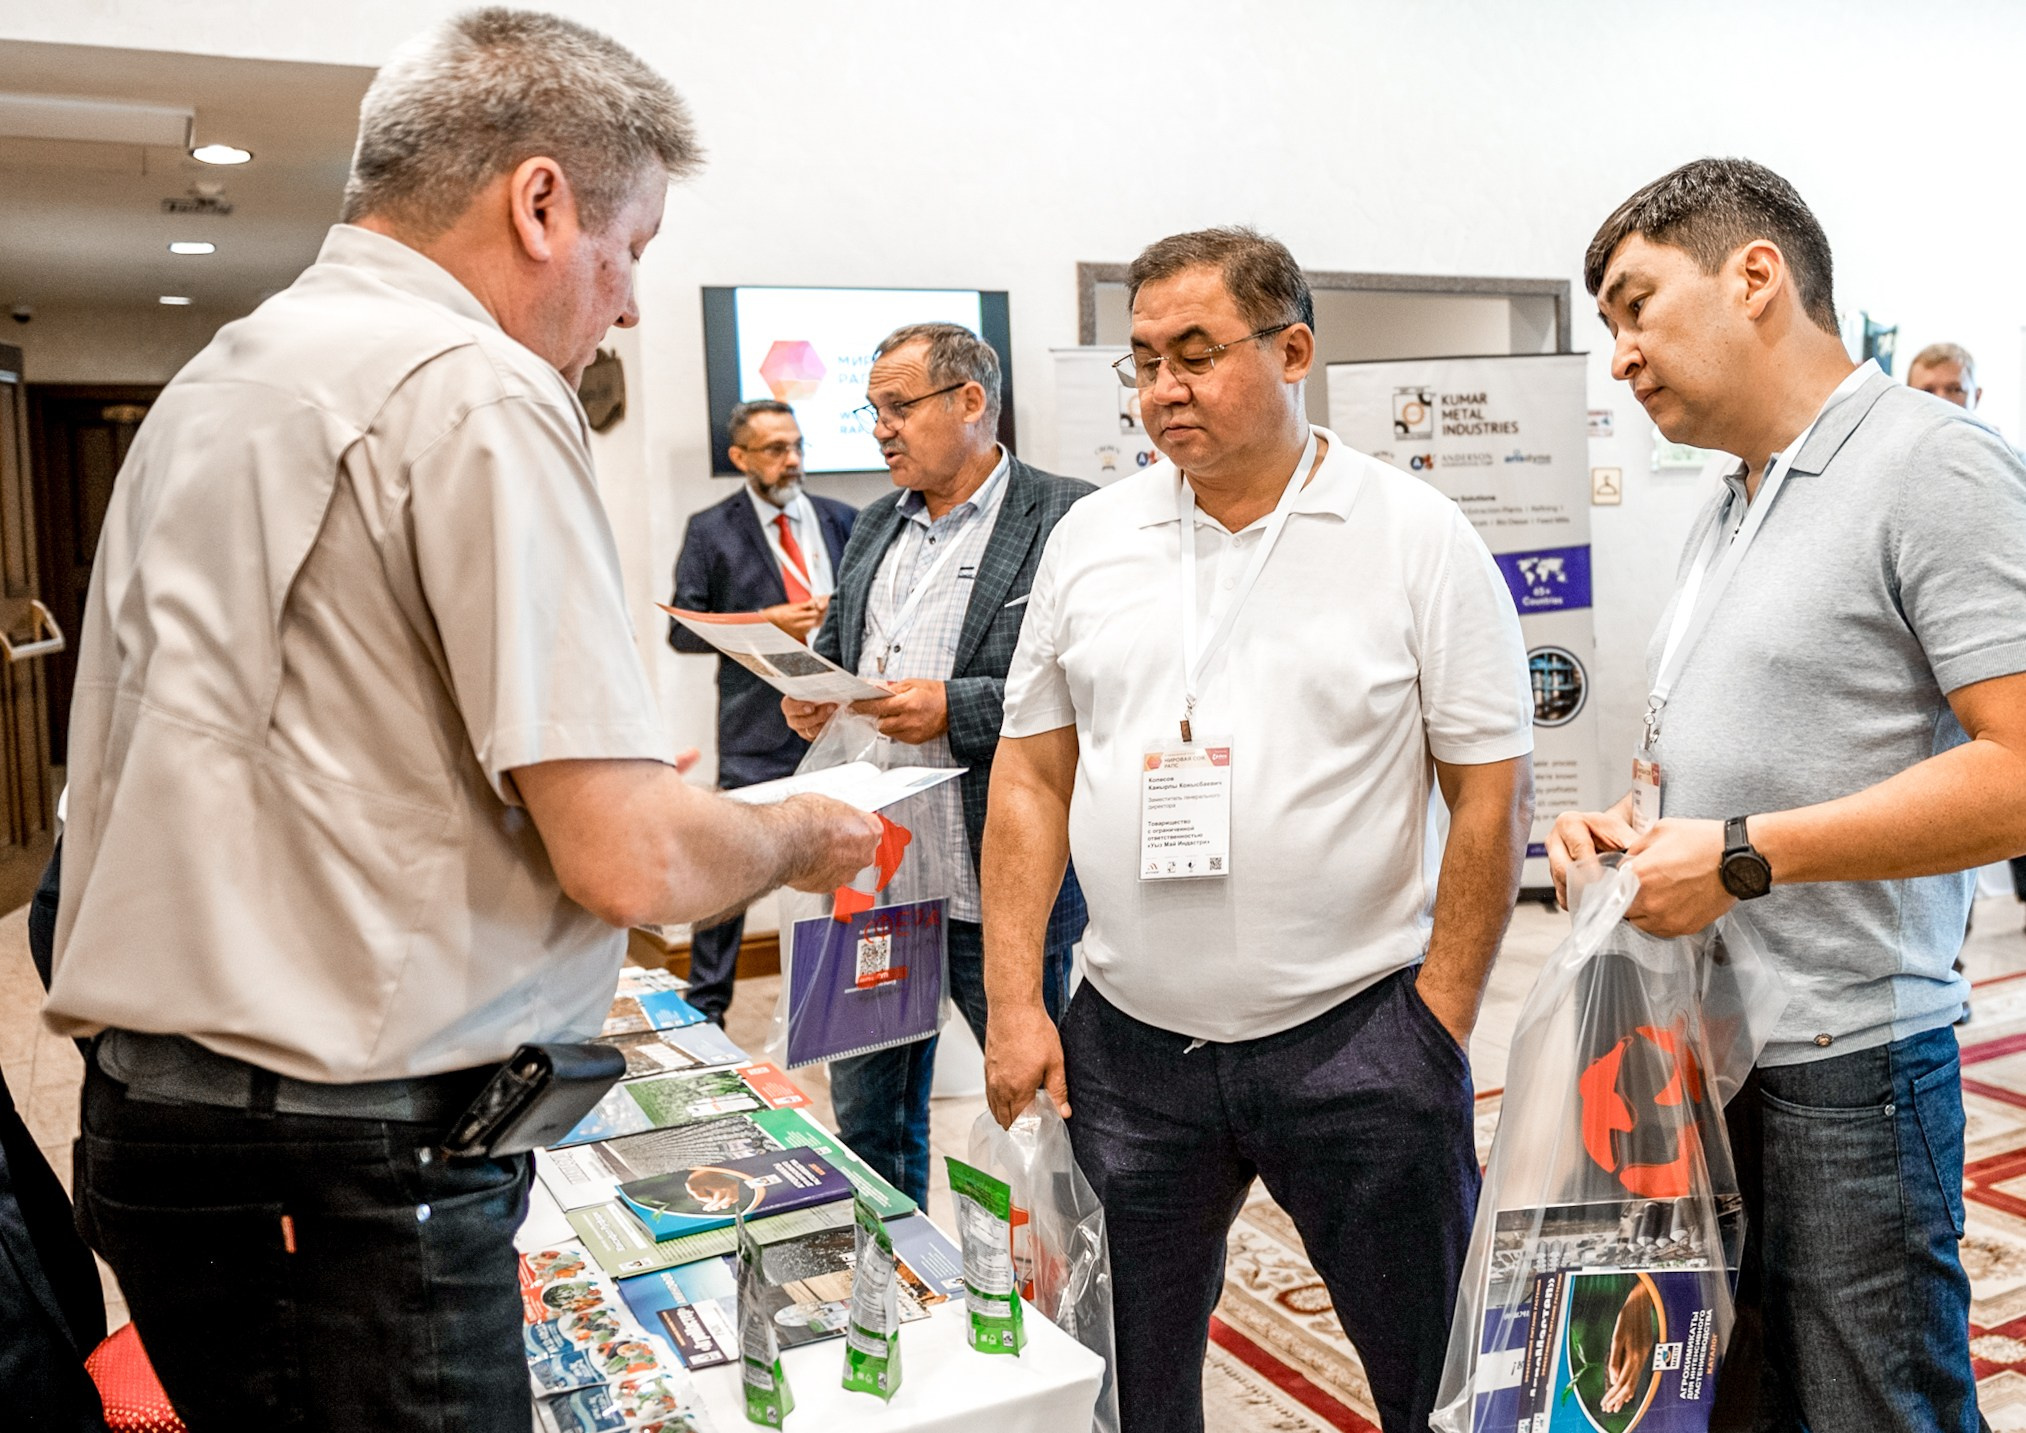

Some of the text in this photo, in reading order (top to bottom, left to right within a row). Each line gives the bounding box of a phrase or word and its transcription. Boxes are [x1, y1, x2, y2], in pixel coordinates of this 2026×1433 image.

[1441, 393, 1487, 406] KUMAR
[1442, 408, 1485, 420] METAL
[1442, 421, 1518, 436] INDUSTRIES
[1522, 596, 1564, 606] Countries
[1152, 826, 1194, 834] ограниченной
[1690, 1310, 1706, 1380] ИНТЕНСИВНОГО
[1680, 1311, 1699, 1400] АГРОХИМИКАТЫ
[1694, 1308, 1713, 1400] РАСТЕНИЕВОДСТВА
[1706, 1333, 1718, 1374] КАТАЛОГ
